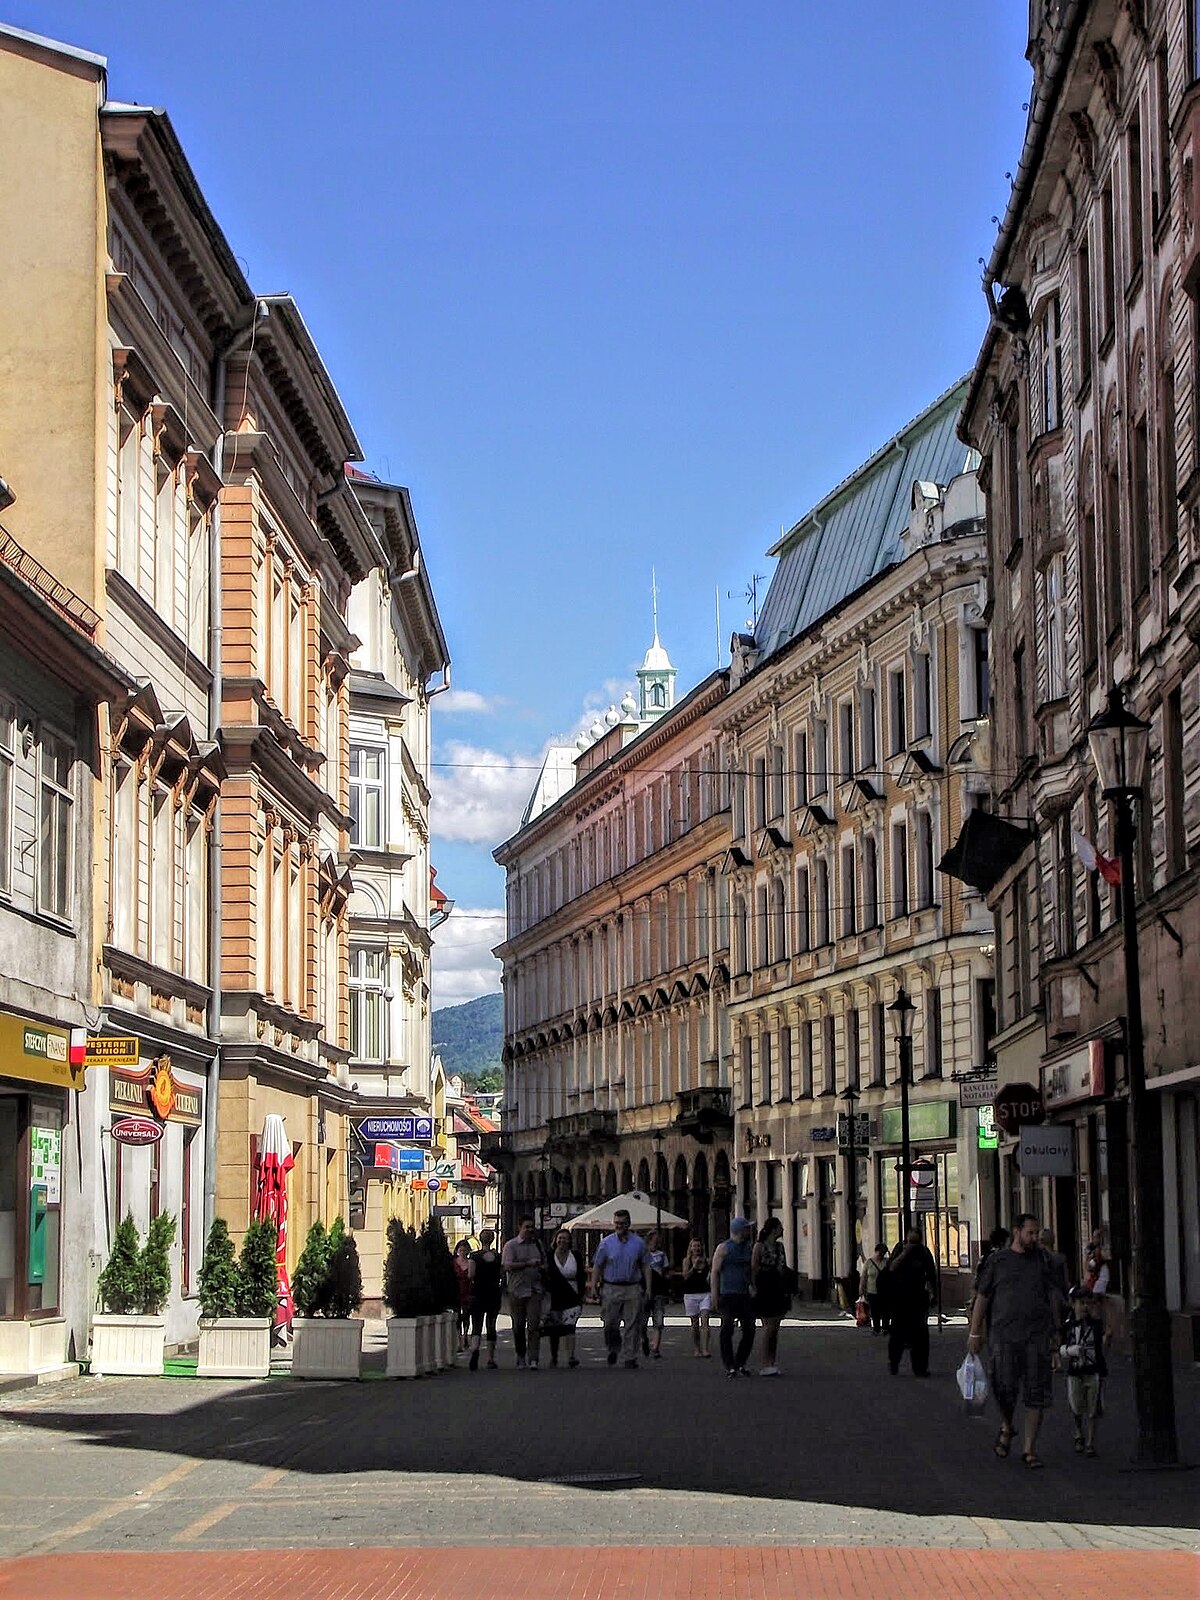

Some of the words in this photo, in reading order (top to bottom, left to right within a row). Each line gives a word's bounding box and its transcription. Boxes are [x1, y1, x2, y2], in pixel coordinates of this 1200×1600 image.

[999, 1101, 1040, 1119] STOP
[115, 1128, 157, 1138] UNIVERSAL
[1024, 1145, 1069, 1157] okulary
